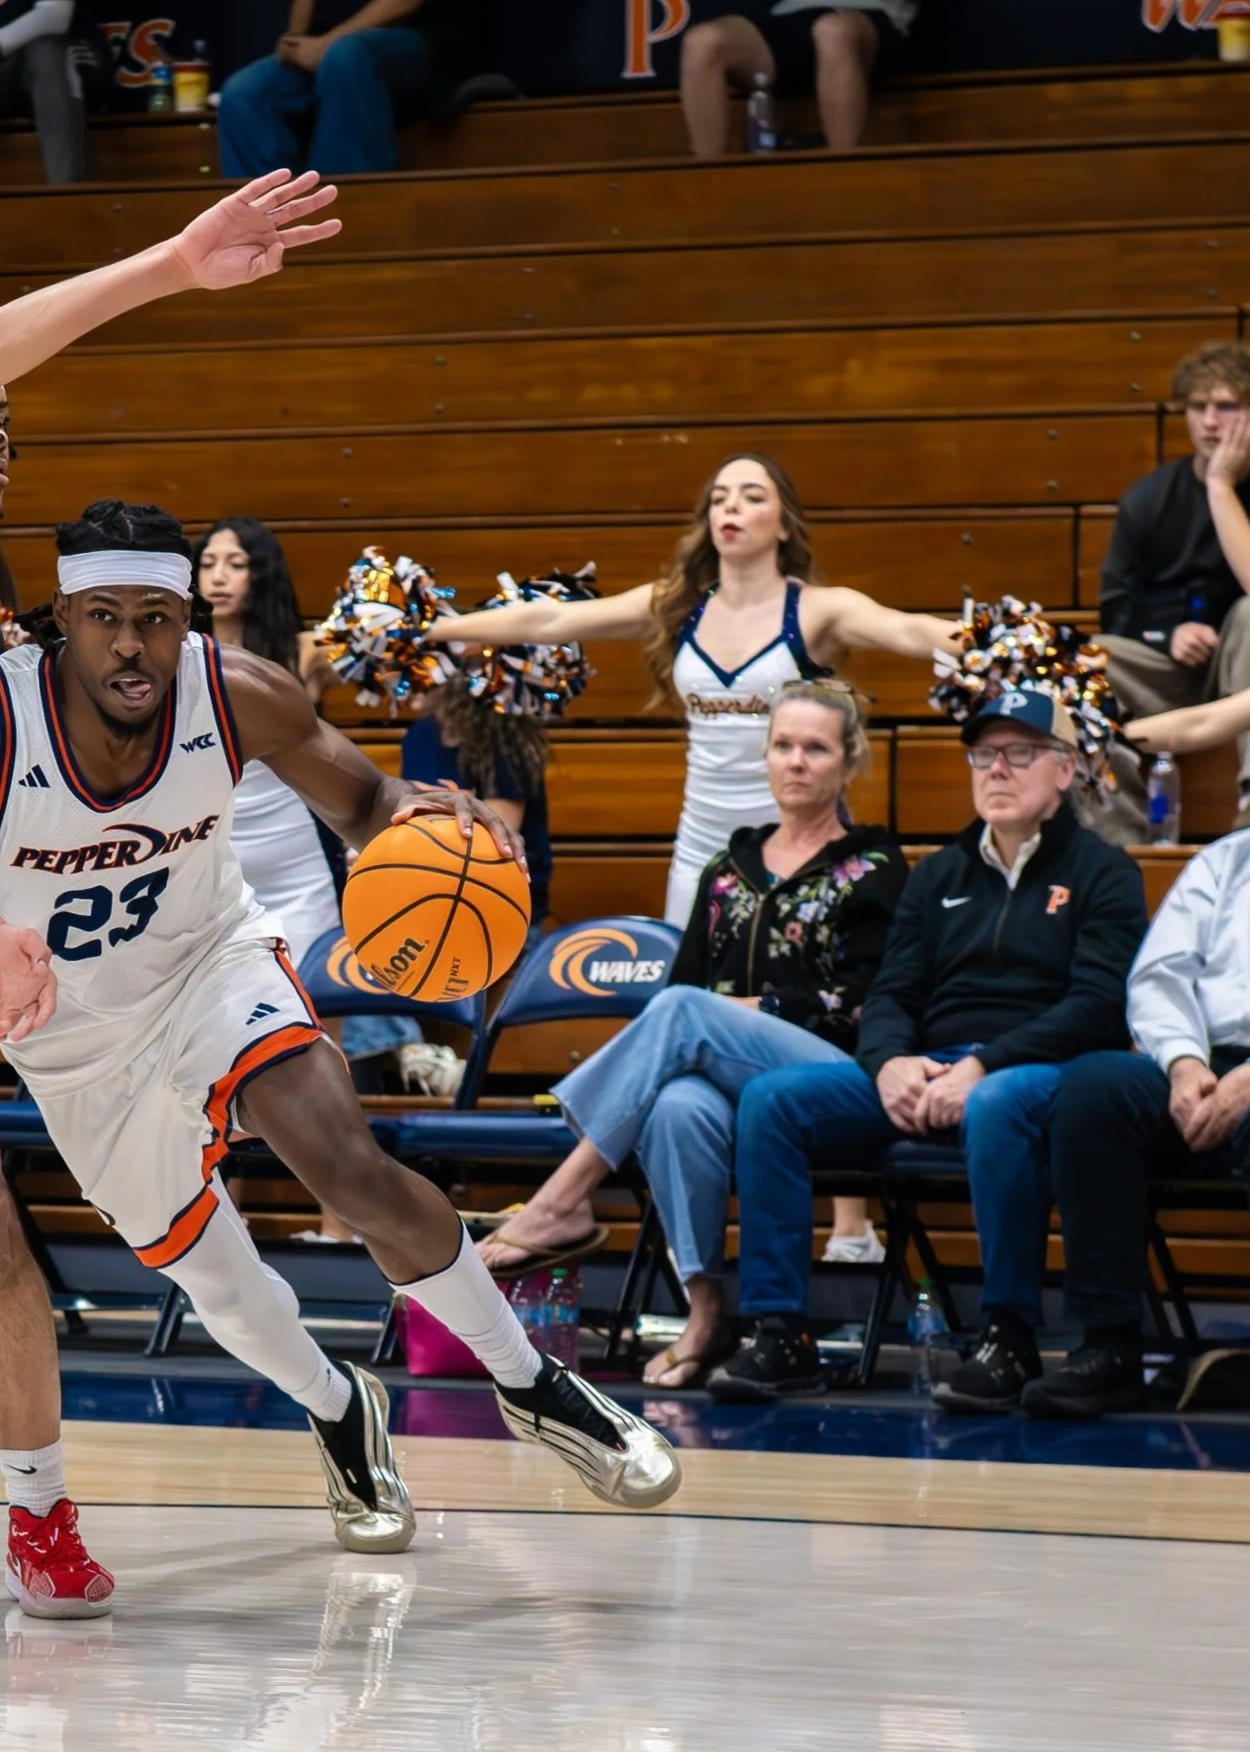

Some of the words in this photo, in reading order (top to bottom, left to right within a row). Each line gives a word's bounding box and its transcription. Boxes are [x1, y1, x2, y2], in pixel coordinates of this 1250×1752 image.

[999, 691, 1029, 716] P
[179, 732, 216, 753] WCC
[10, 814, 220, 875] PEPPERDINE
[1046, 885, 1071, 914] P
[46, 866, 170, 962] 23
[588, 959, 666, 983] WAVES
